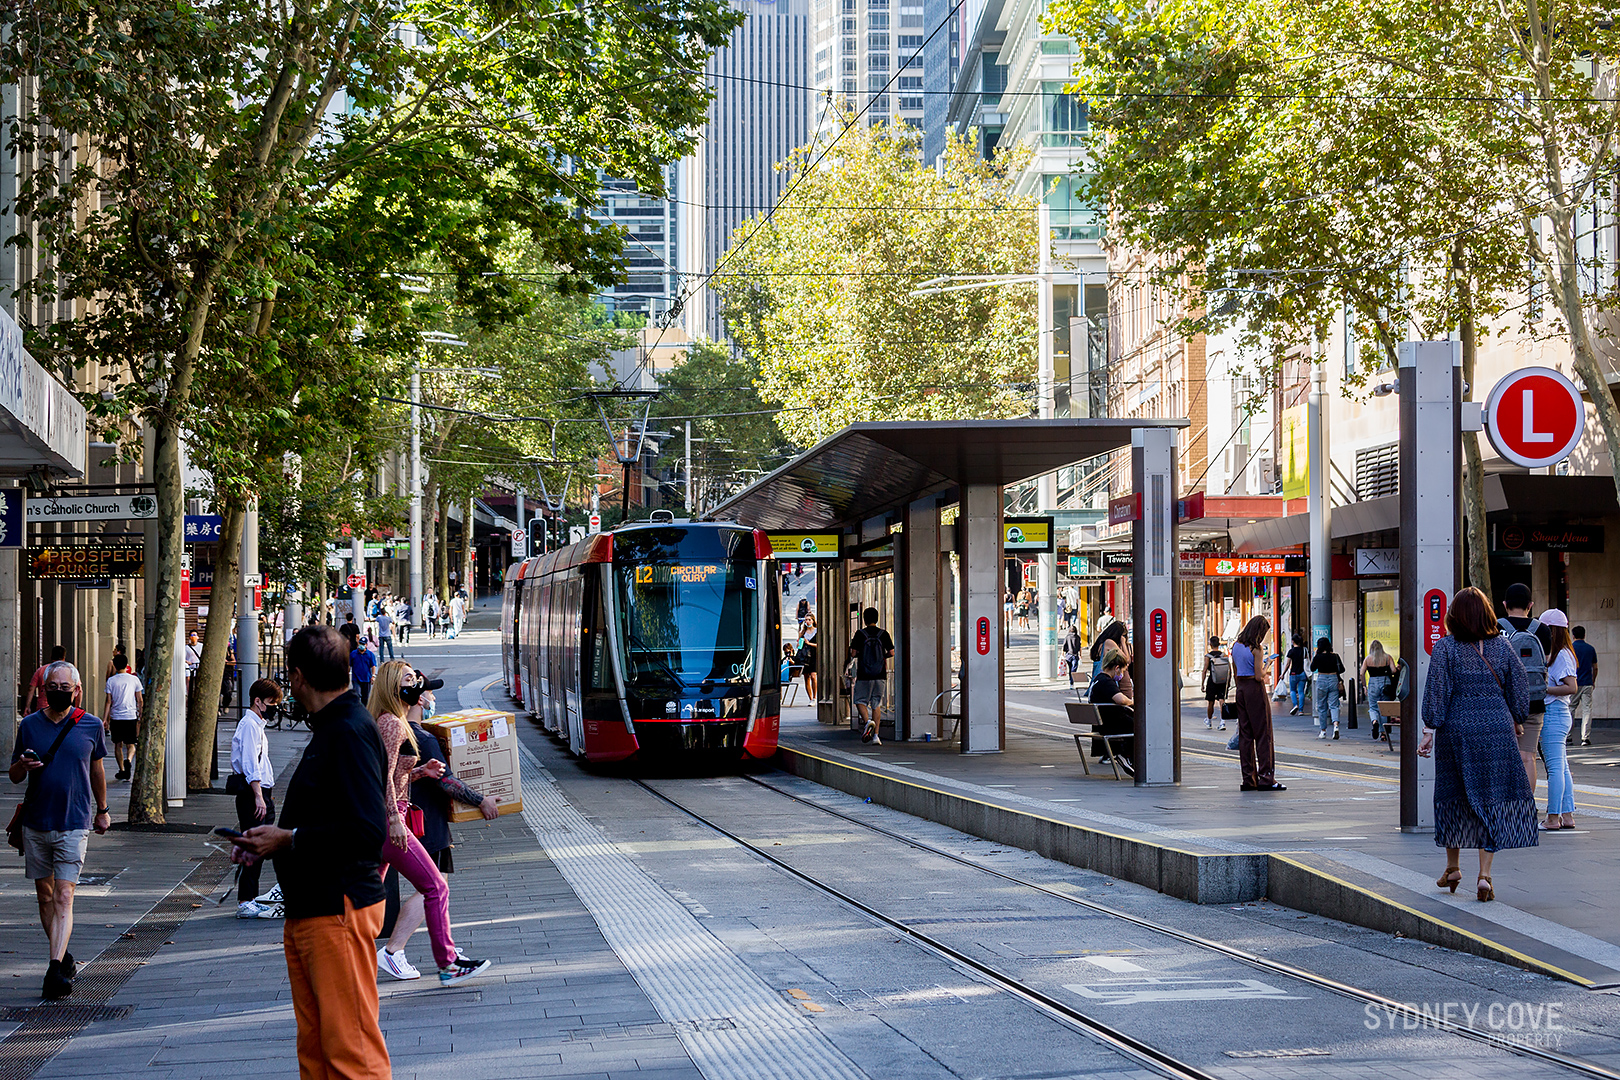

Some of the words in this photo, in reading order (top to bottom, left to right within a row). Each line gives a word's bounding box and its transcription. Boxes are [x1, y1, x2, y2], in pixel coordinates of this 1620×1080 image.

[1522, 389, 1554, 443] L
[43, 504, 83, 516] Catholic
[84, 502, 120, 514] Church
[47, 564, 109, 574] LOUNGE
[635, 566, 653, 583] L2
[670, 565, 717, 575] CIRCULAR
[681, 573, 707, 582] QUAY
